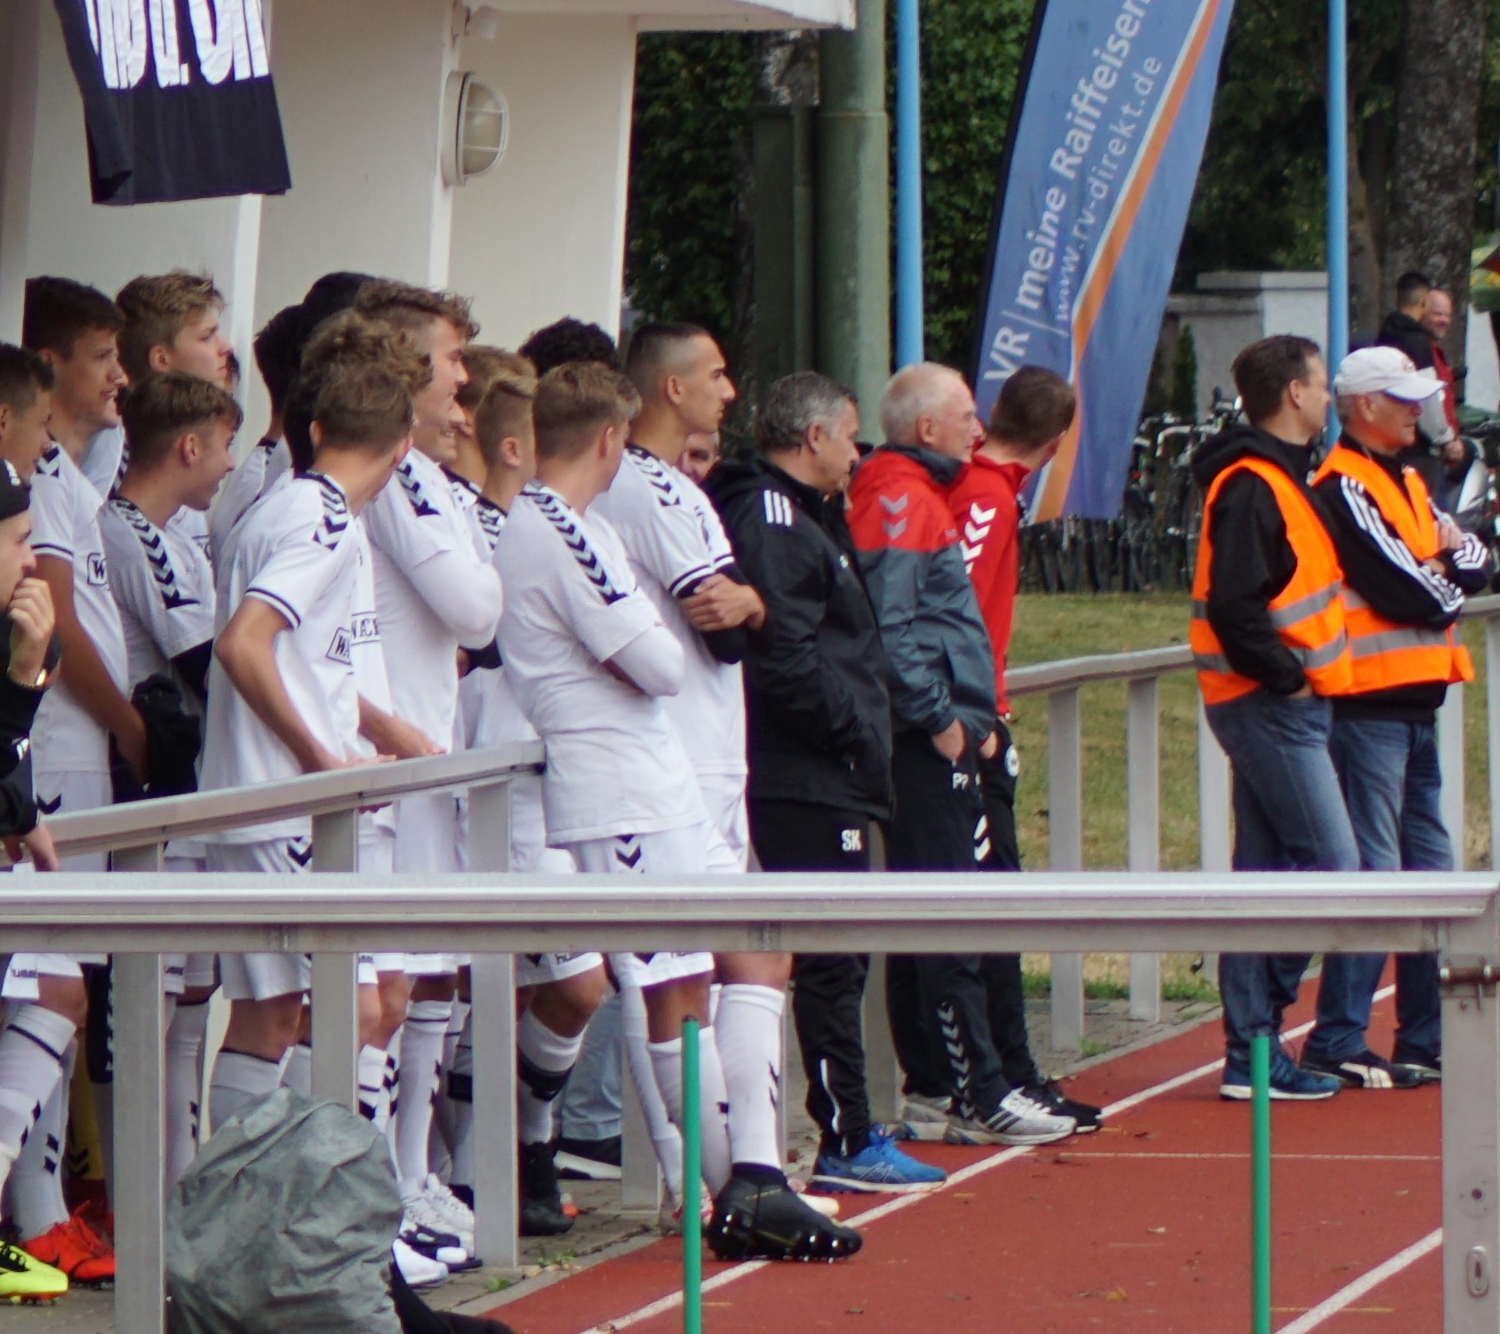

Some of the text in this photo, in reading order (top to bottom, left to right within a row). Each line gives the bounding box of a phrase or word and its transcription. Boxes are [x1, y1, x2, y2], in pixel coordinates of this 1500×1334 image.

[984, 324, 1031, 380] VR
[1015, 187, 1067, 311] meine
[841, 829, 862, 852] SK
